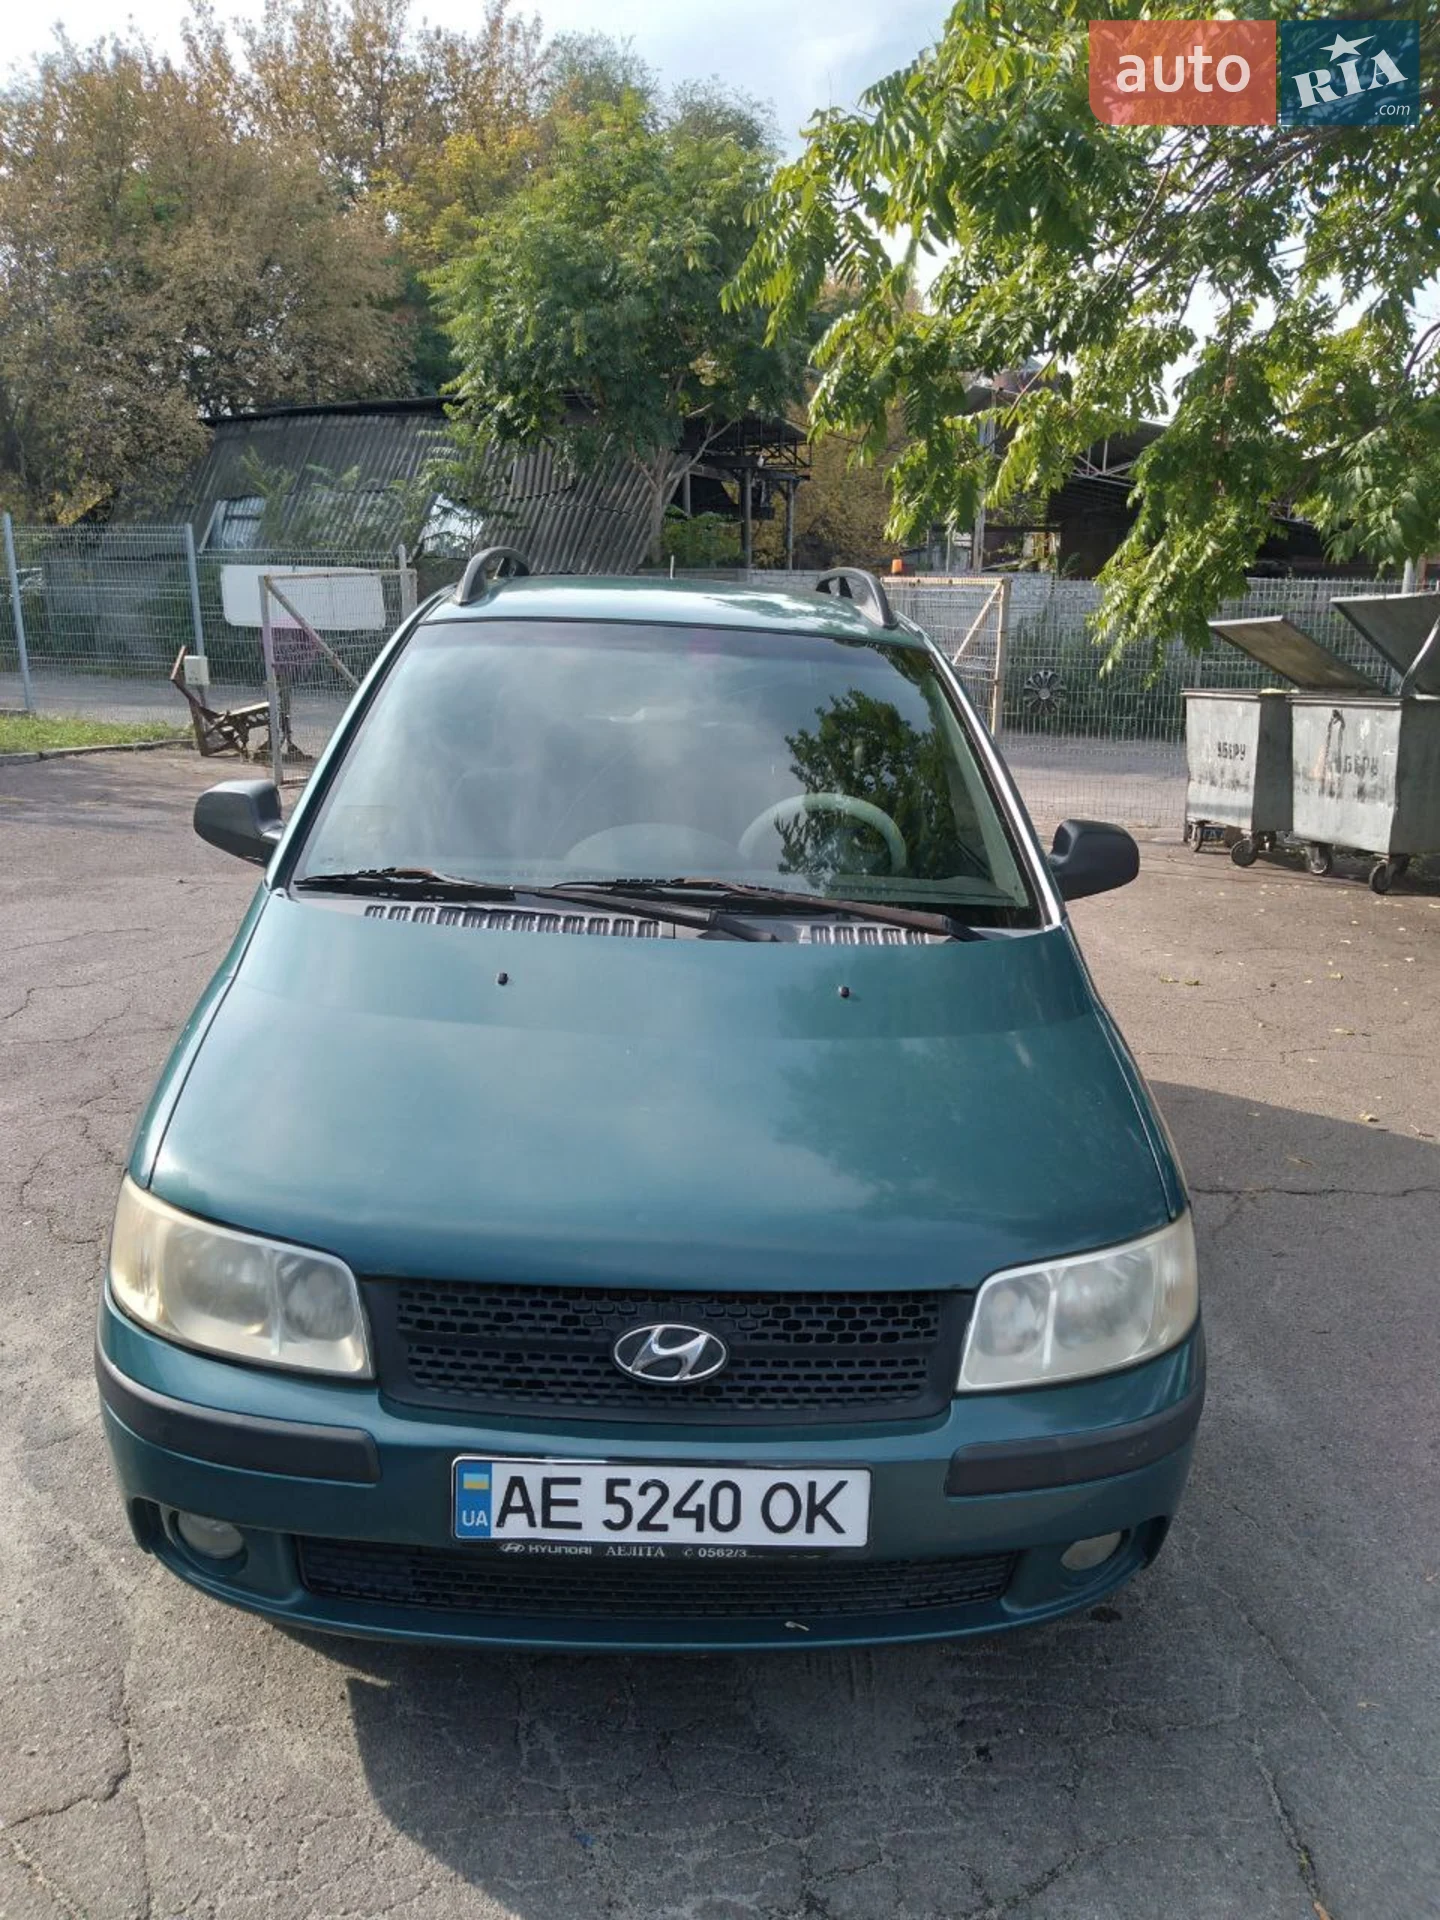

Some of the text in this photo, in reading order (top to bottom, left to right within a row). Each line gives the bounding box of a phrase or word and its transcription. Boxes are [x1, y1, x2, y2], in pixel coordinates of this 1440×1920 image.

[496, 1475, 849, 1534] AE 5240 OK
[462, 1510, 488, 1527] UA
[528, 1544, 593, 1556] HYUNDAI
